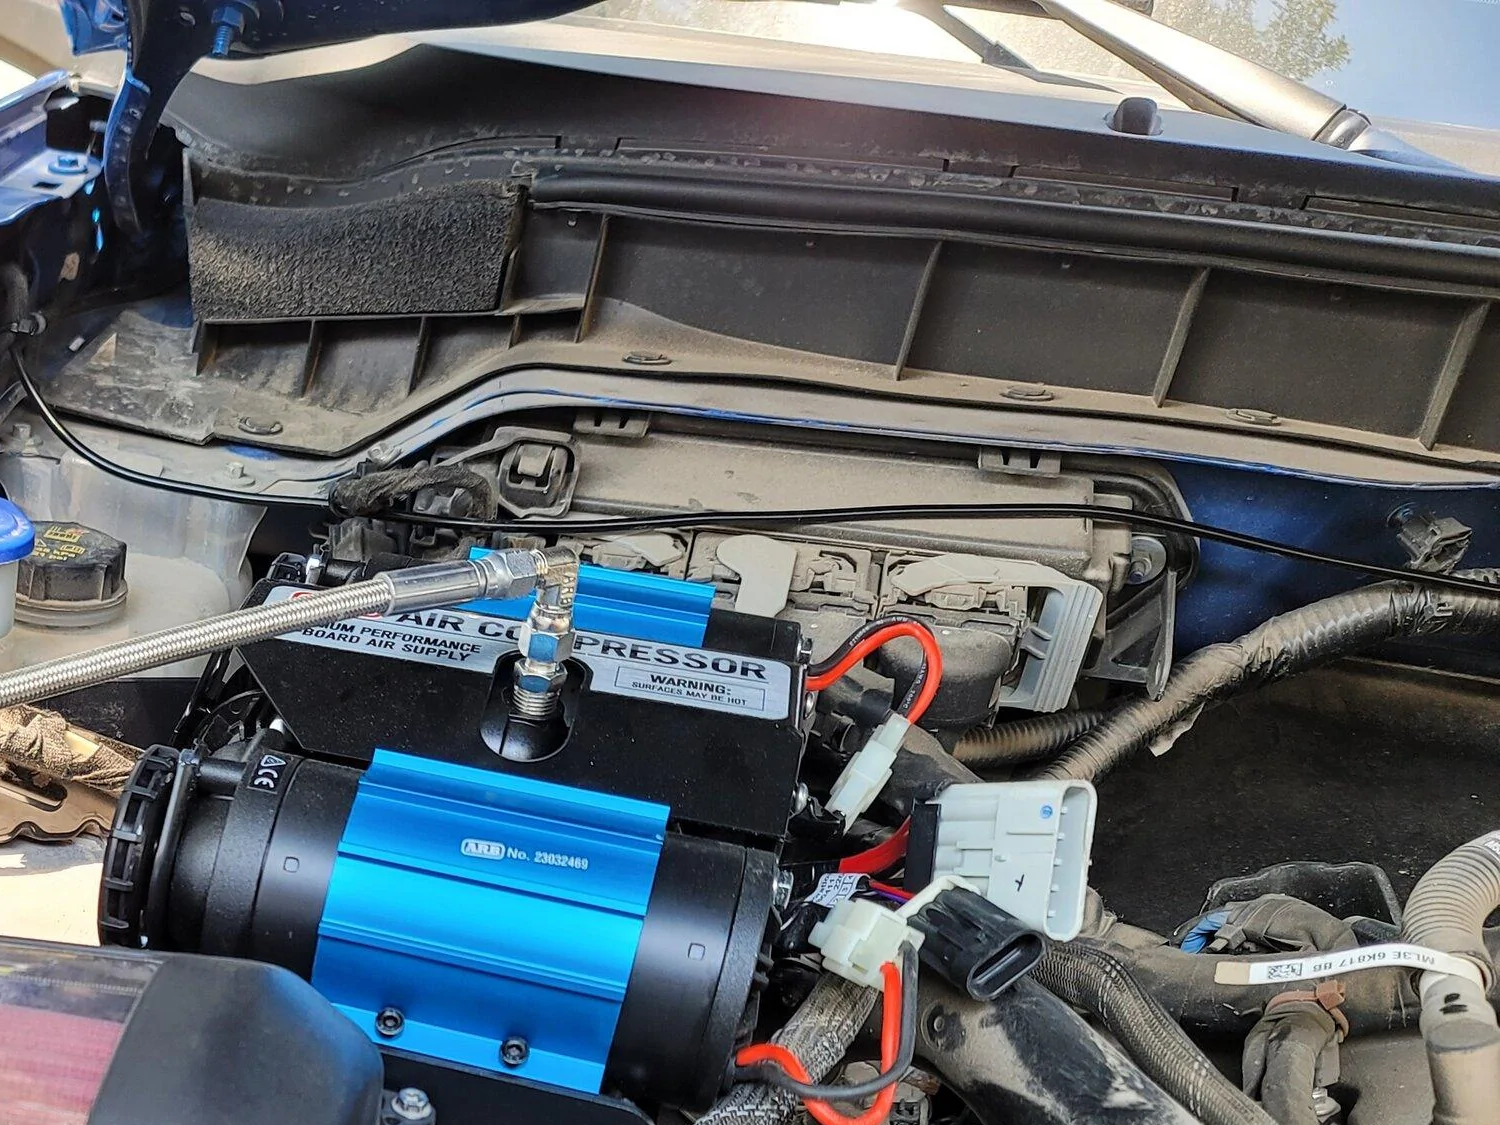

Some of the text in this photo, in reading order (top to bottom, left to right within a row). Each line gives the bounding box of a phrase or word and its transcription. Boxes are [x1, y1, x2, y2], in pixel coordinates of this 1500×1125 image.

[303, 628, 471, 662] BOARD AIR SUPPLY
[360, 627, 481, 654] PERFORMANCE
[396, 612, 767, 680] AIR COPRESSOR
[632, 681, 683, 696] SURFACES
[686, 691, 706, 700] MAY
[728, 697, 747, 706] HOT
[650, 674, 732, 695] WARNING:
[462, 839, 589, 870] ARB No. 23032469
[1338, 951, 1387, 968] 6K817
[1393, 950, 1435, 966] ML3E
